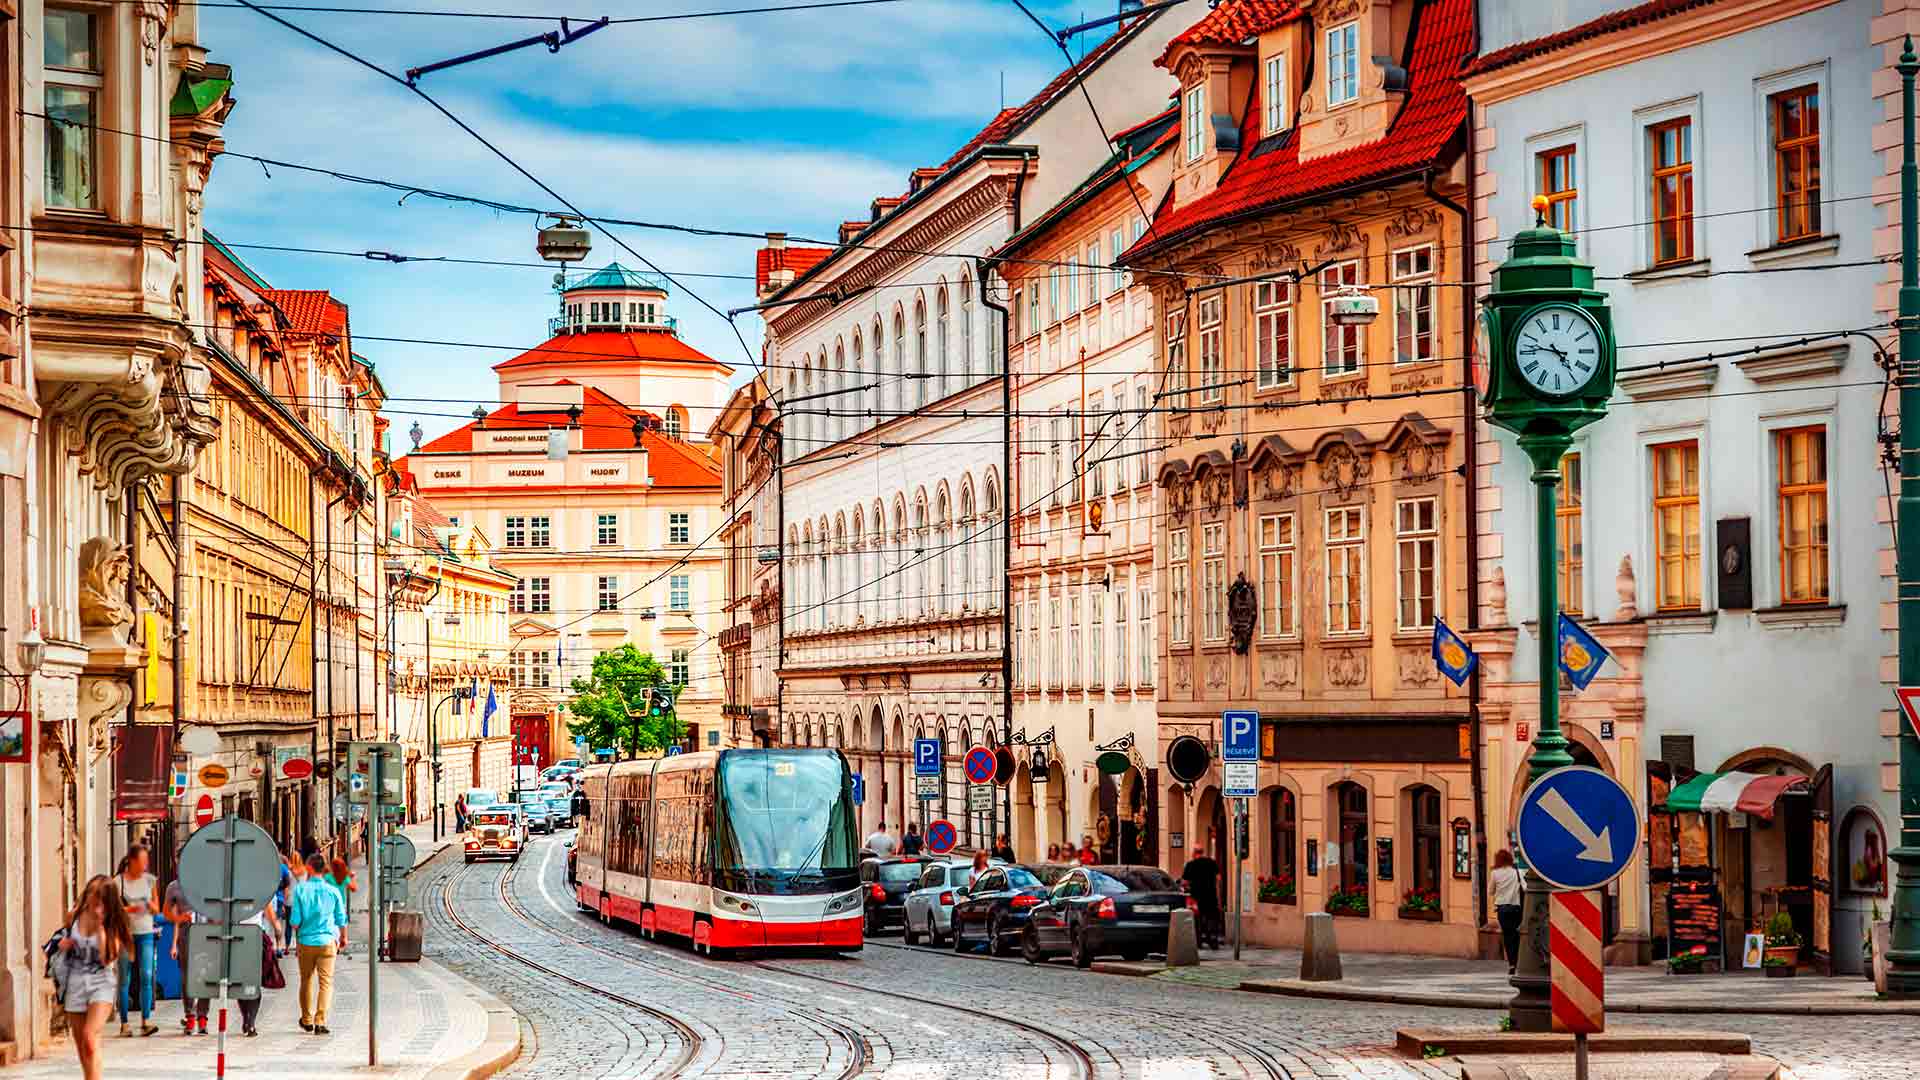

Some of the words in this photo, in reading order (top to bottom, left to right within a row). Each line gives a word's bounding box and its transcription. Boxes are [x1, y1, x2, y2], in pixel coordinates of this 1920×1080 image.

[527, 434, 549, 442] MUZE
[433, 469, 462, 479] ČESKÉ
[508, 469, 545, 477] MUZEUM
[590, 468, 620, 476] HUDBY
[1231, 717, 1251, 745] P
[920, 743, 935, 764] P
